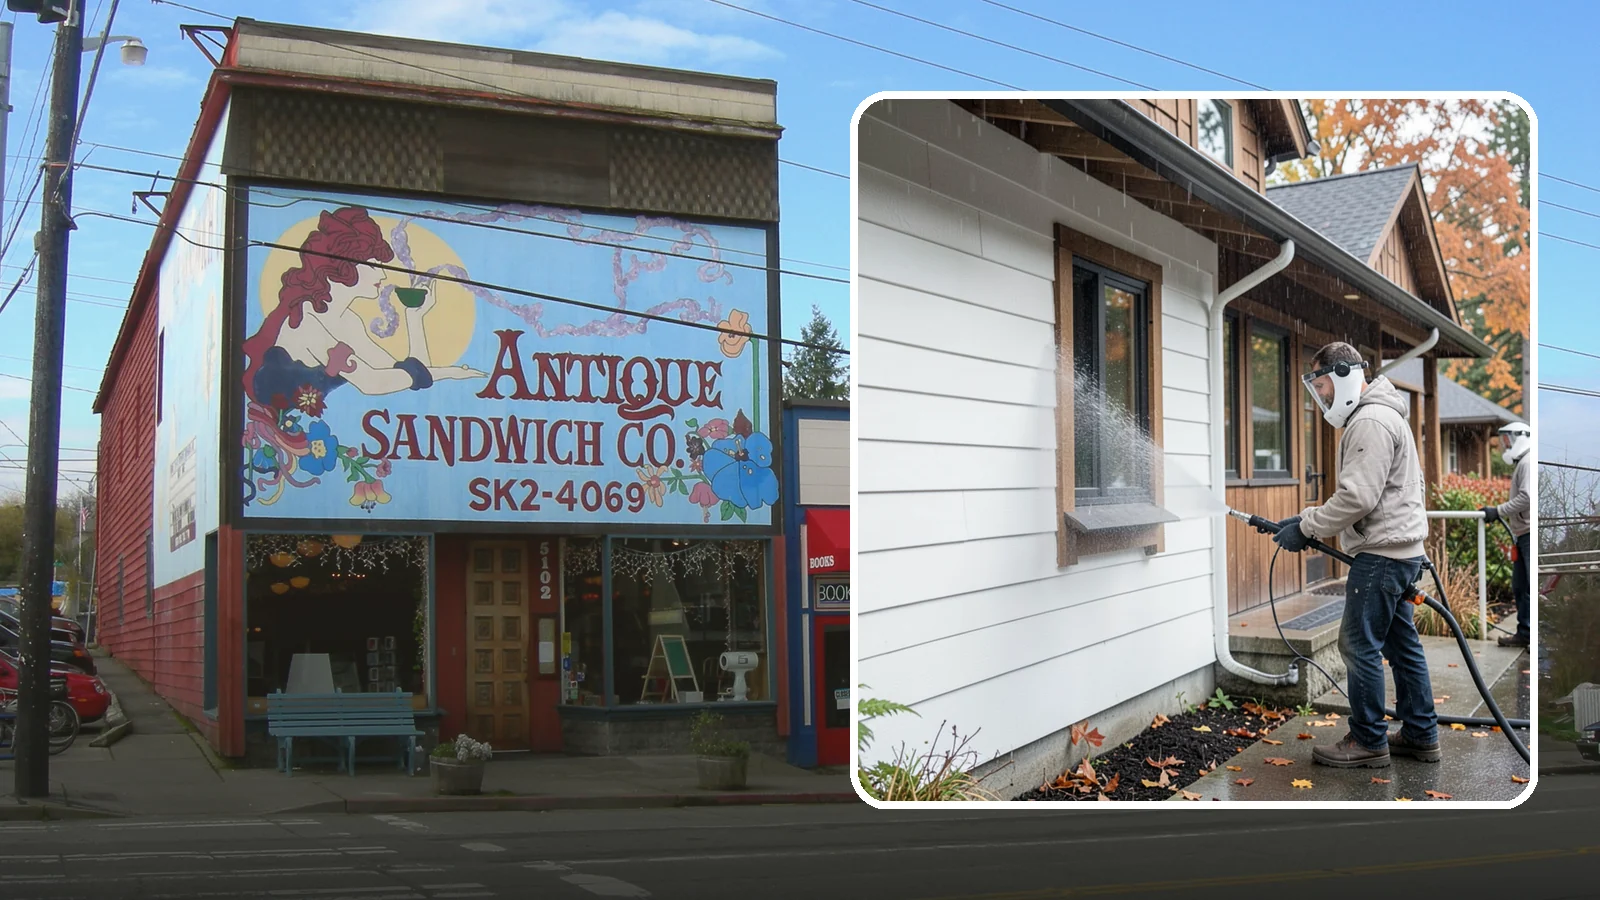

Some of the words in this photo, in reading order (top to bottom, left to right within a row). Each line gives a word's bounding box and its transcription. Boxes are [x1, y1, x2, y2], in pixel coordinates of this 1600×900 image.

[475, 329, 723, 420] ANTIQUE
[361, 408, 604, 467] SANDWICH
[616, 422, 685, 469] CO.
[468, 477, 646, 513] SK2-4069
[540, 542, 551, 599] 5102
[809, 555, 834, 569] BOOKS
